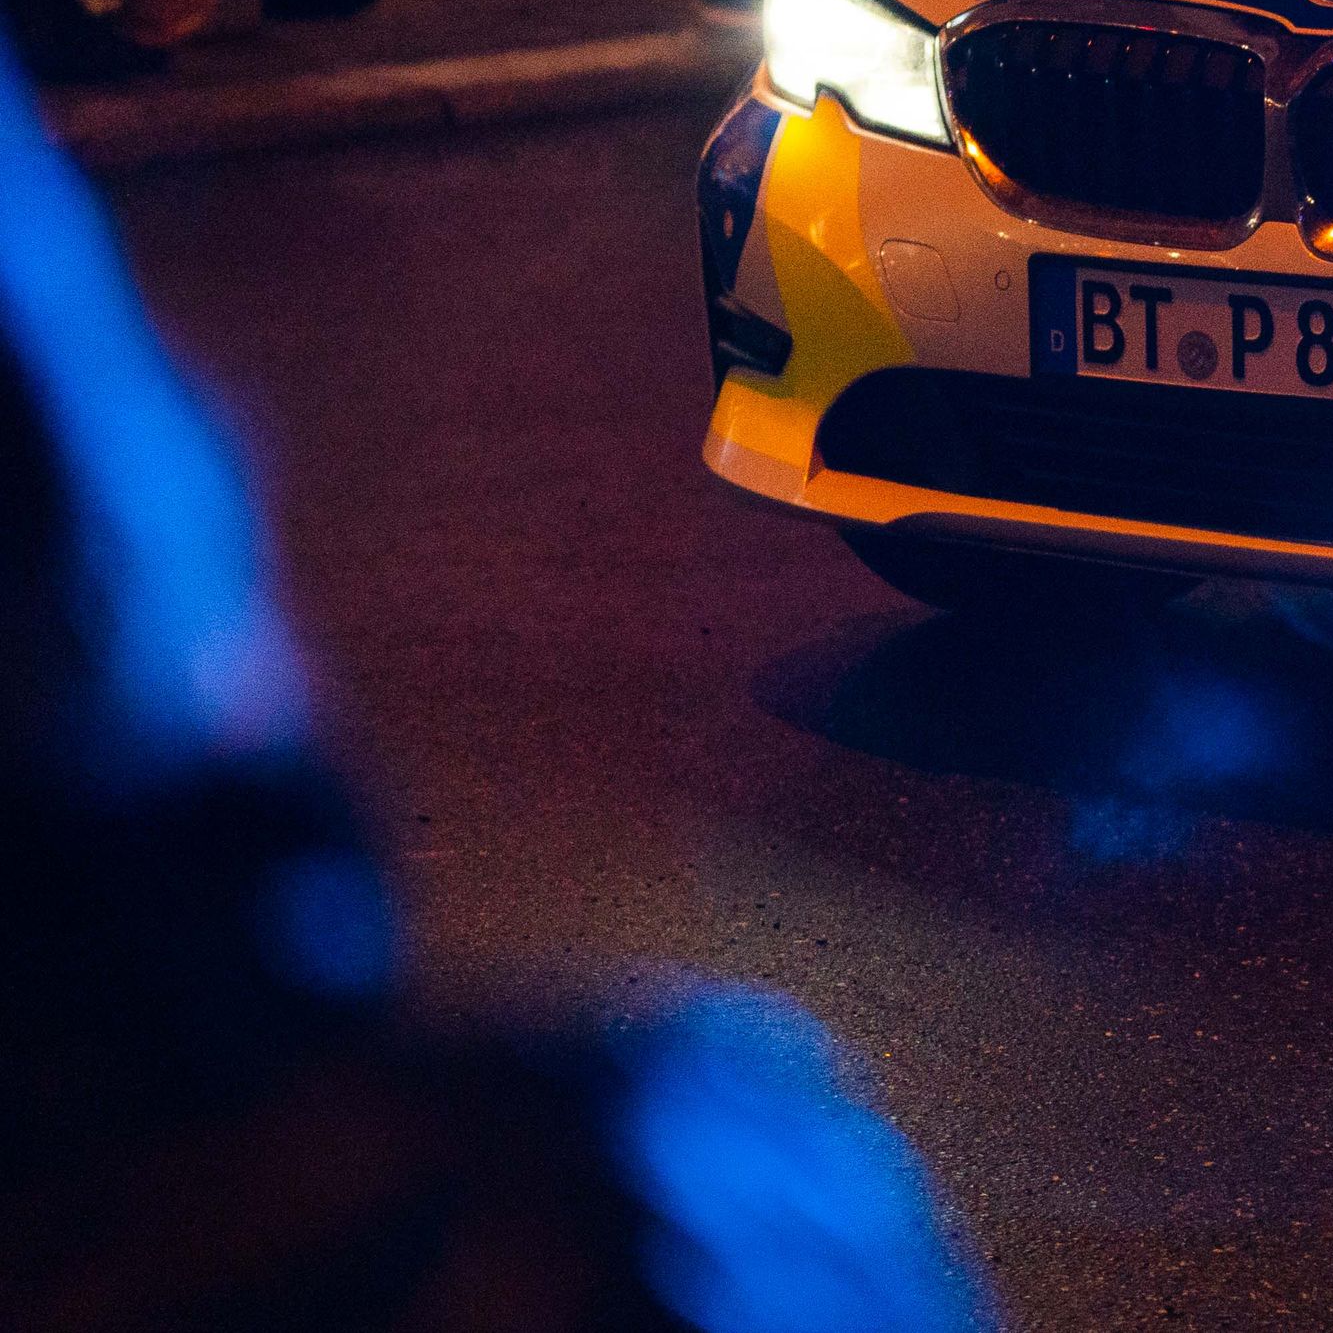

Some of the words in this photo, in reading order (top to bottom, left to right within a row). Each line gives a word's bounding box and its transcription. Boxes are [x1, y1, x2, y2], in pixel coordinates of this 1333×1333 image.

[1050, 329, 1065, 352] D
[1081, 280, 1173, 371] BT
[1228, 294, 1275, 380] P
